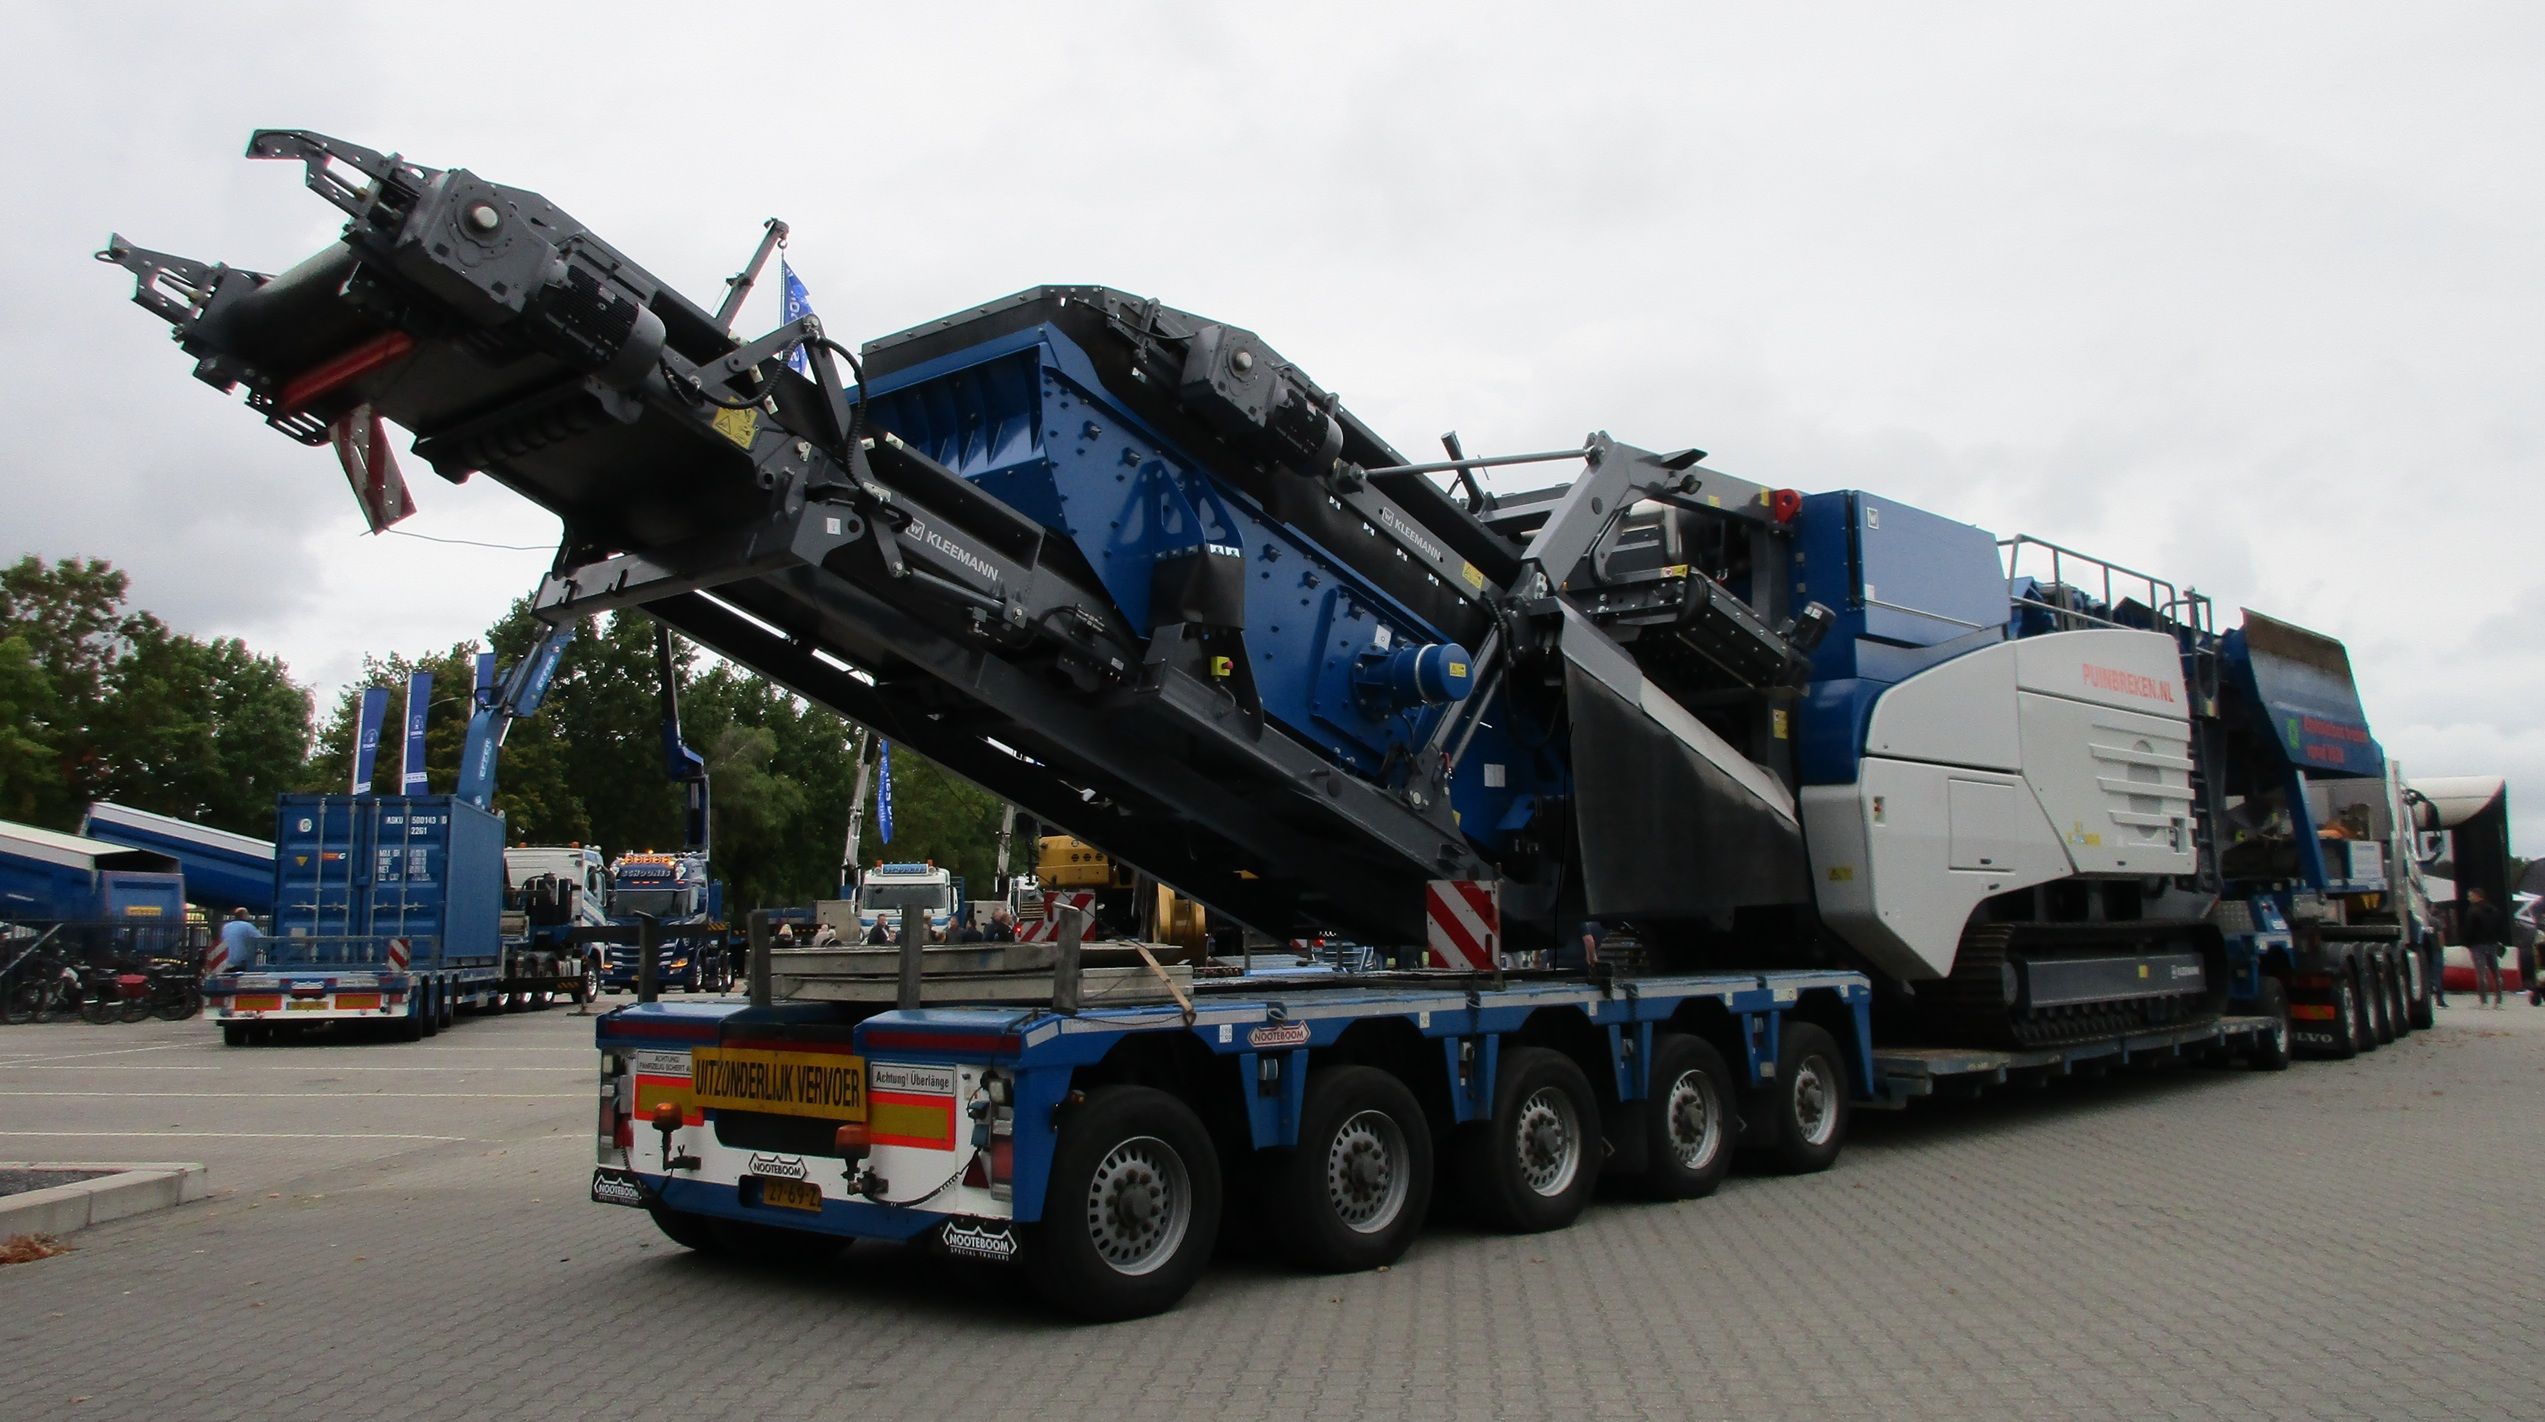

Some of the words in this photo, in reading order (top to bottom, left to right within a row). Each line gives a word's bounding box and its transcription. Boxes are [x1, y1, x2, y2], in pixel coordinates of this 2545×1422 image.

[1394, 518, 1441, 561] KLEEMANN
[926, 530, 999, 581] KLEEMANN
[2081, 662, 2175, 703] PUINBREKEN.NL
[1254, 1030, 1304, 1042] NOOTEBOOM
[2292, 1032, 2334, 1044] LVO
[695, 1059, 794, 1102] UITZONDERLIJK
[797, 1064, 860, 1108] VERVOER
[876, 1070, 909, 1088] Achtung!
[911, 1071, 950, 1090] Überlänge
[753, 1162, 802, 1176] NOOTEBOOM
[598, 1184, 640, 1198] NOOTEBOOM
[949, 1233, 1010, 1252] NOOTEBOOM
[950, 1247, 977, 1257] SPECIAL
[979, 1251, 1010, 1261] TRAILERS
